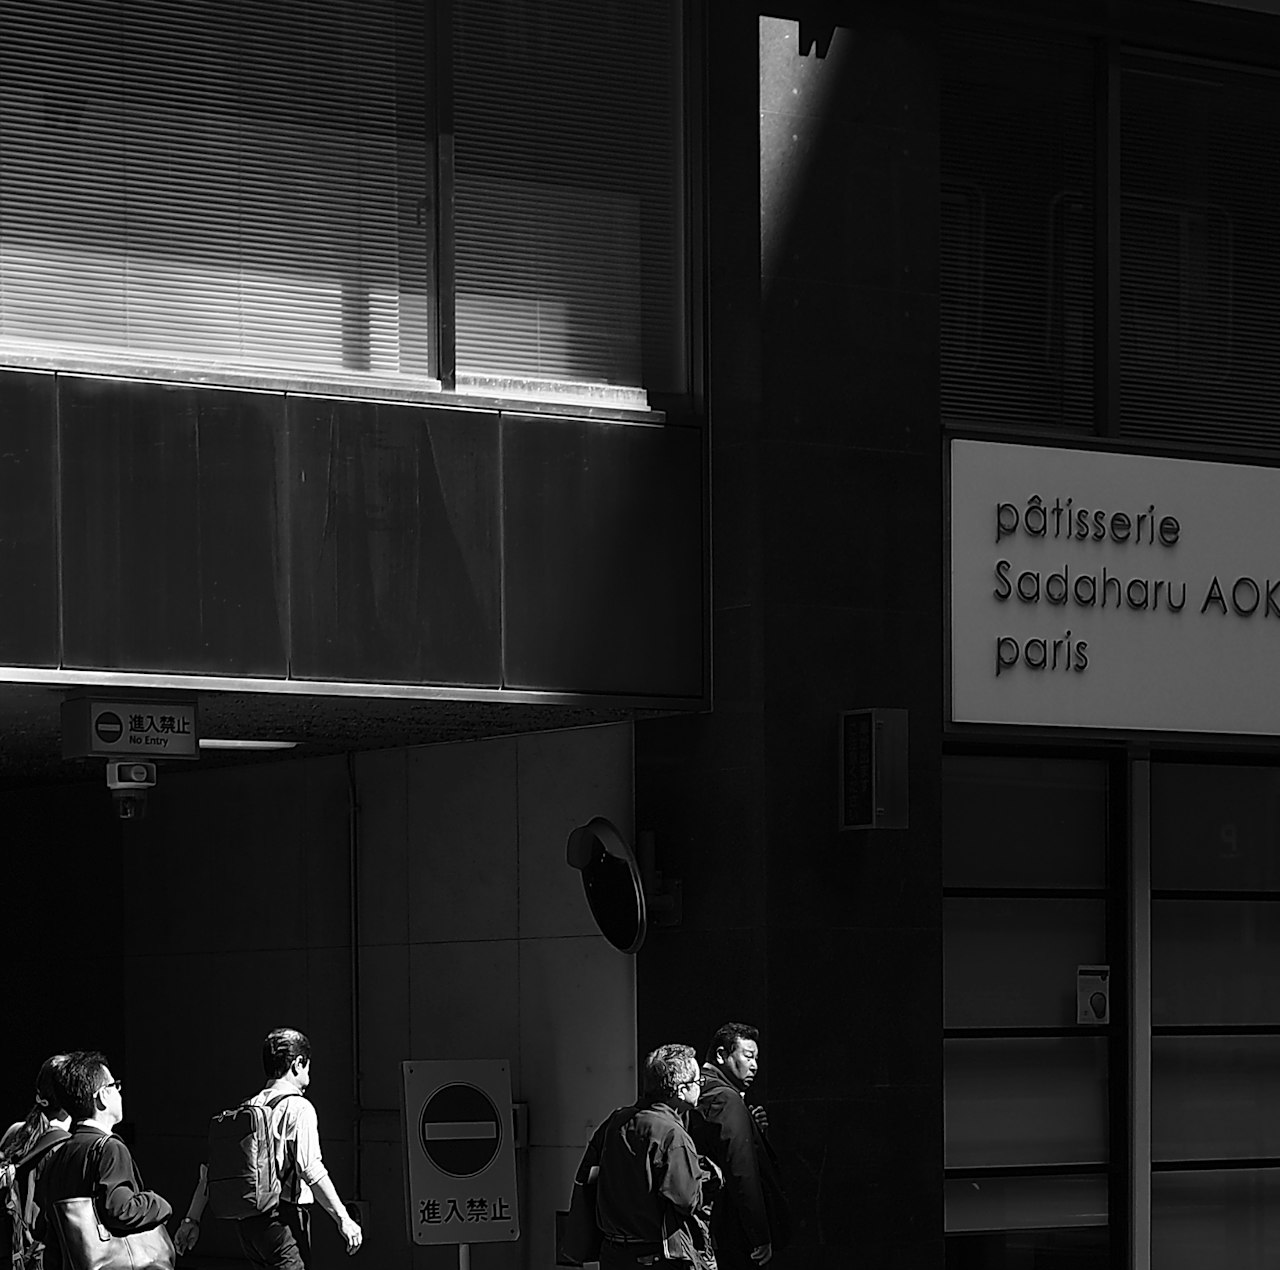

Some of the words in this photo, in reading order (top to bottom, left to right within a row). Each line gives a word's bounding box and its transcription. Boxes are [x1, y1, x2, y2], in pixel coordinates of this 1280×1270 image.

[995, 494, 1181, 545] pâtisserie
[993, 560, 1186, 613] Sadaharu
[995, 630, 1089, 677] paris
[128, 714, 191, 734] 進入禁止
[129, 735, 142, 745] No
[144, 735, 169, 748] Entry
[419, 1197, 512, 1225] 進入禁止
